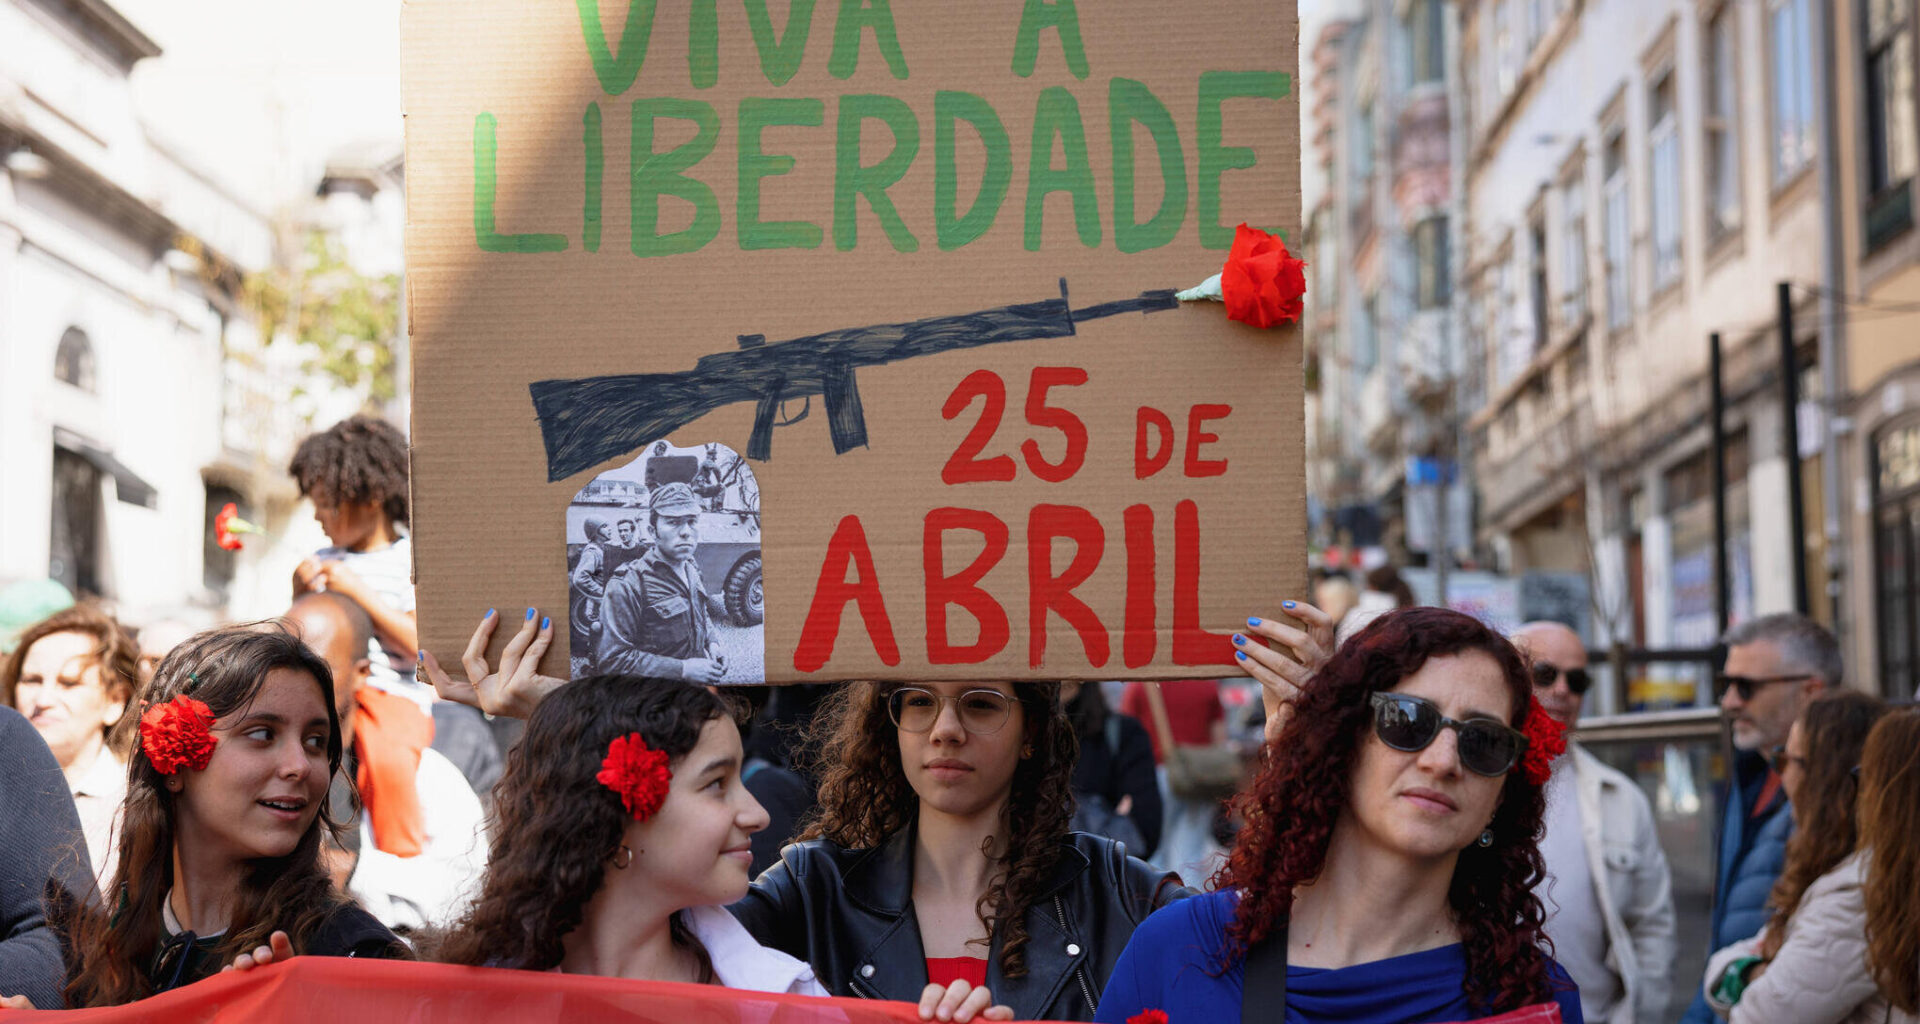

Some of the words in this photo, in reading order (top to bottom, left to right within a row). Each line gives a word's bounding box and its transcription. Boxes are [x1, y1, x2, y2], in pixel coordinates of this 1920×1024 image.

[578, 0, 909, 96] VIVA
[1011, 0, 1090, 81] A
[474, 70, 1291, 257] LIBERDADE
[941, 367, 1089, 485] 25
[1134, 403, 1232, 480] DE
[794, 499, 1270, 672] ABRIL
